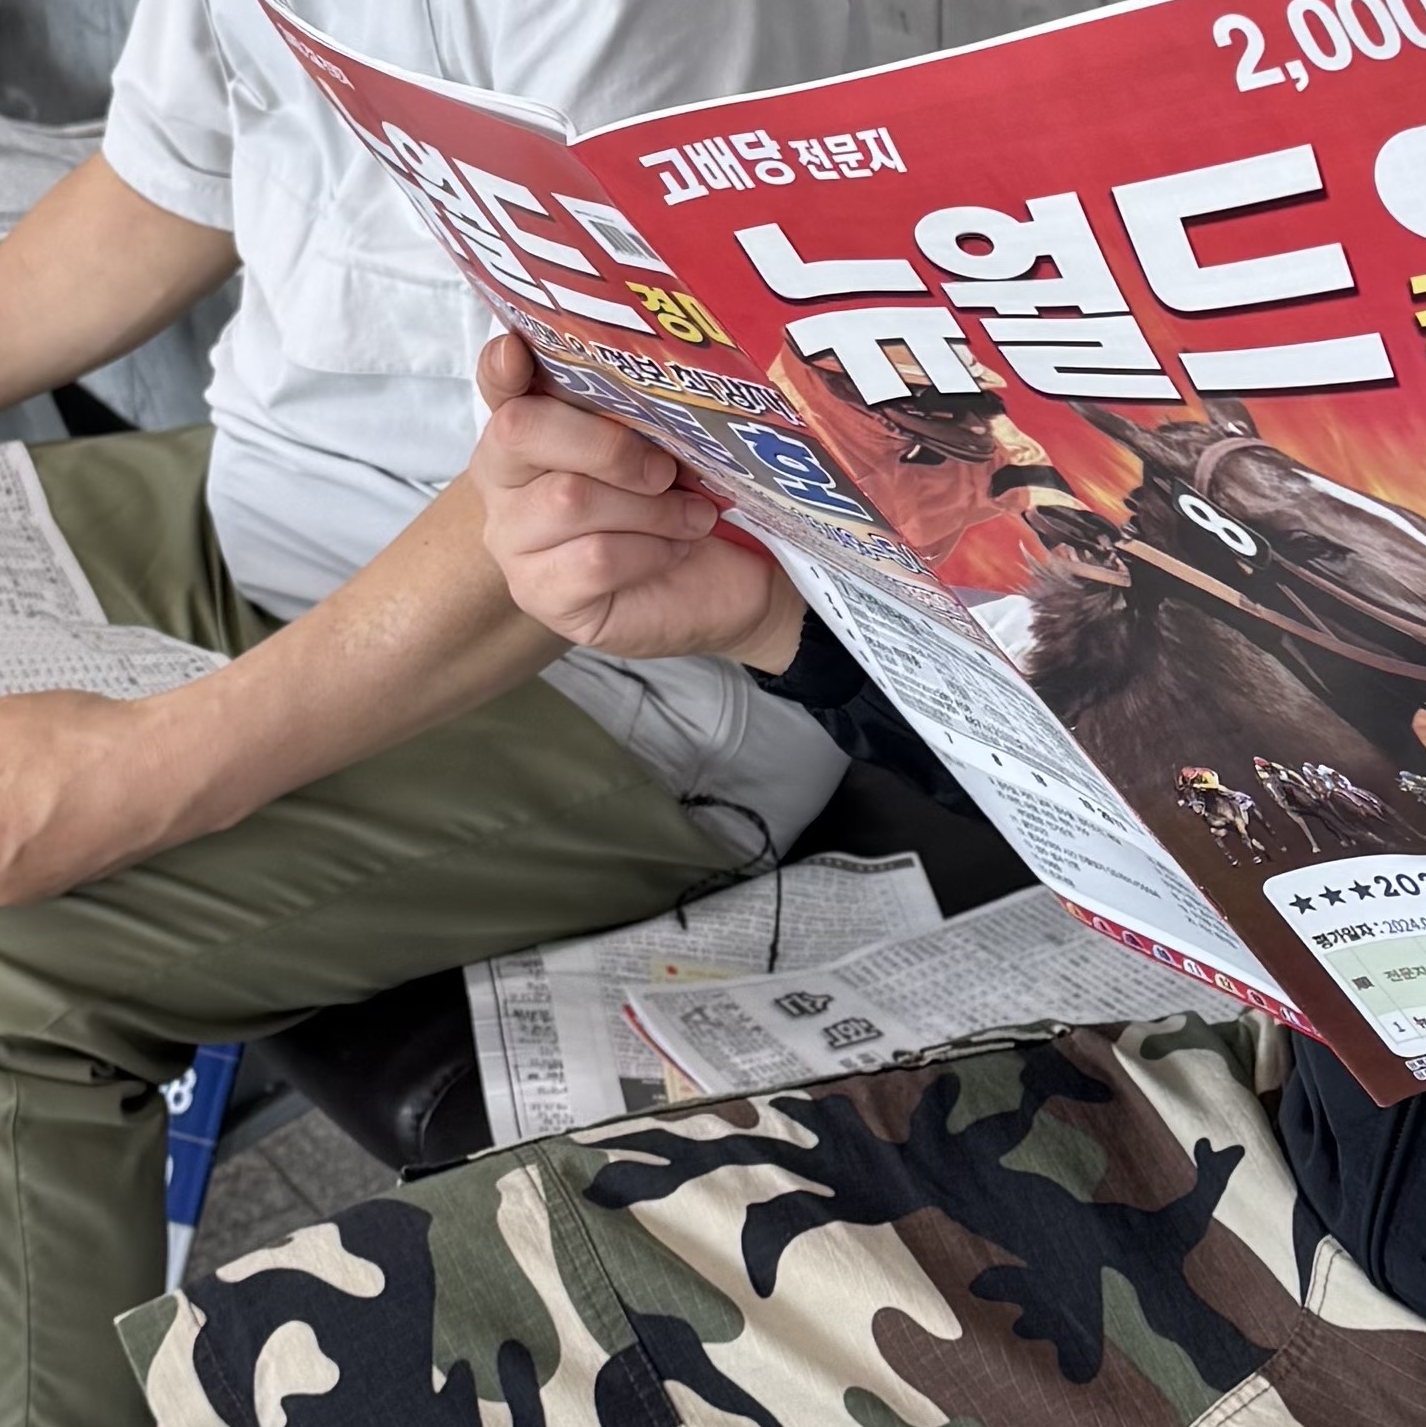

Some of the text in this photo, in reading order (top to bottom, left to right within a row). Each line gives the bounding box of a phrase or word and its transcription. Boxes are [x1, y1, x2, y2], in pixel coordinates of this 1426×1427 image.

[639, 127, 908, 206] 고배당 전문지
[734, 143, 1395, 406] 뉴월드
[1178, 493, 1257, 557] 8
[1312, 922, 1376, 950] 평가일자
[1392, 1020, 1406, 1033] 1
